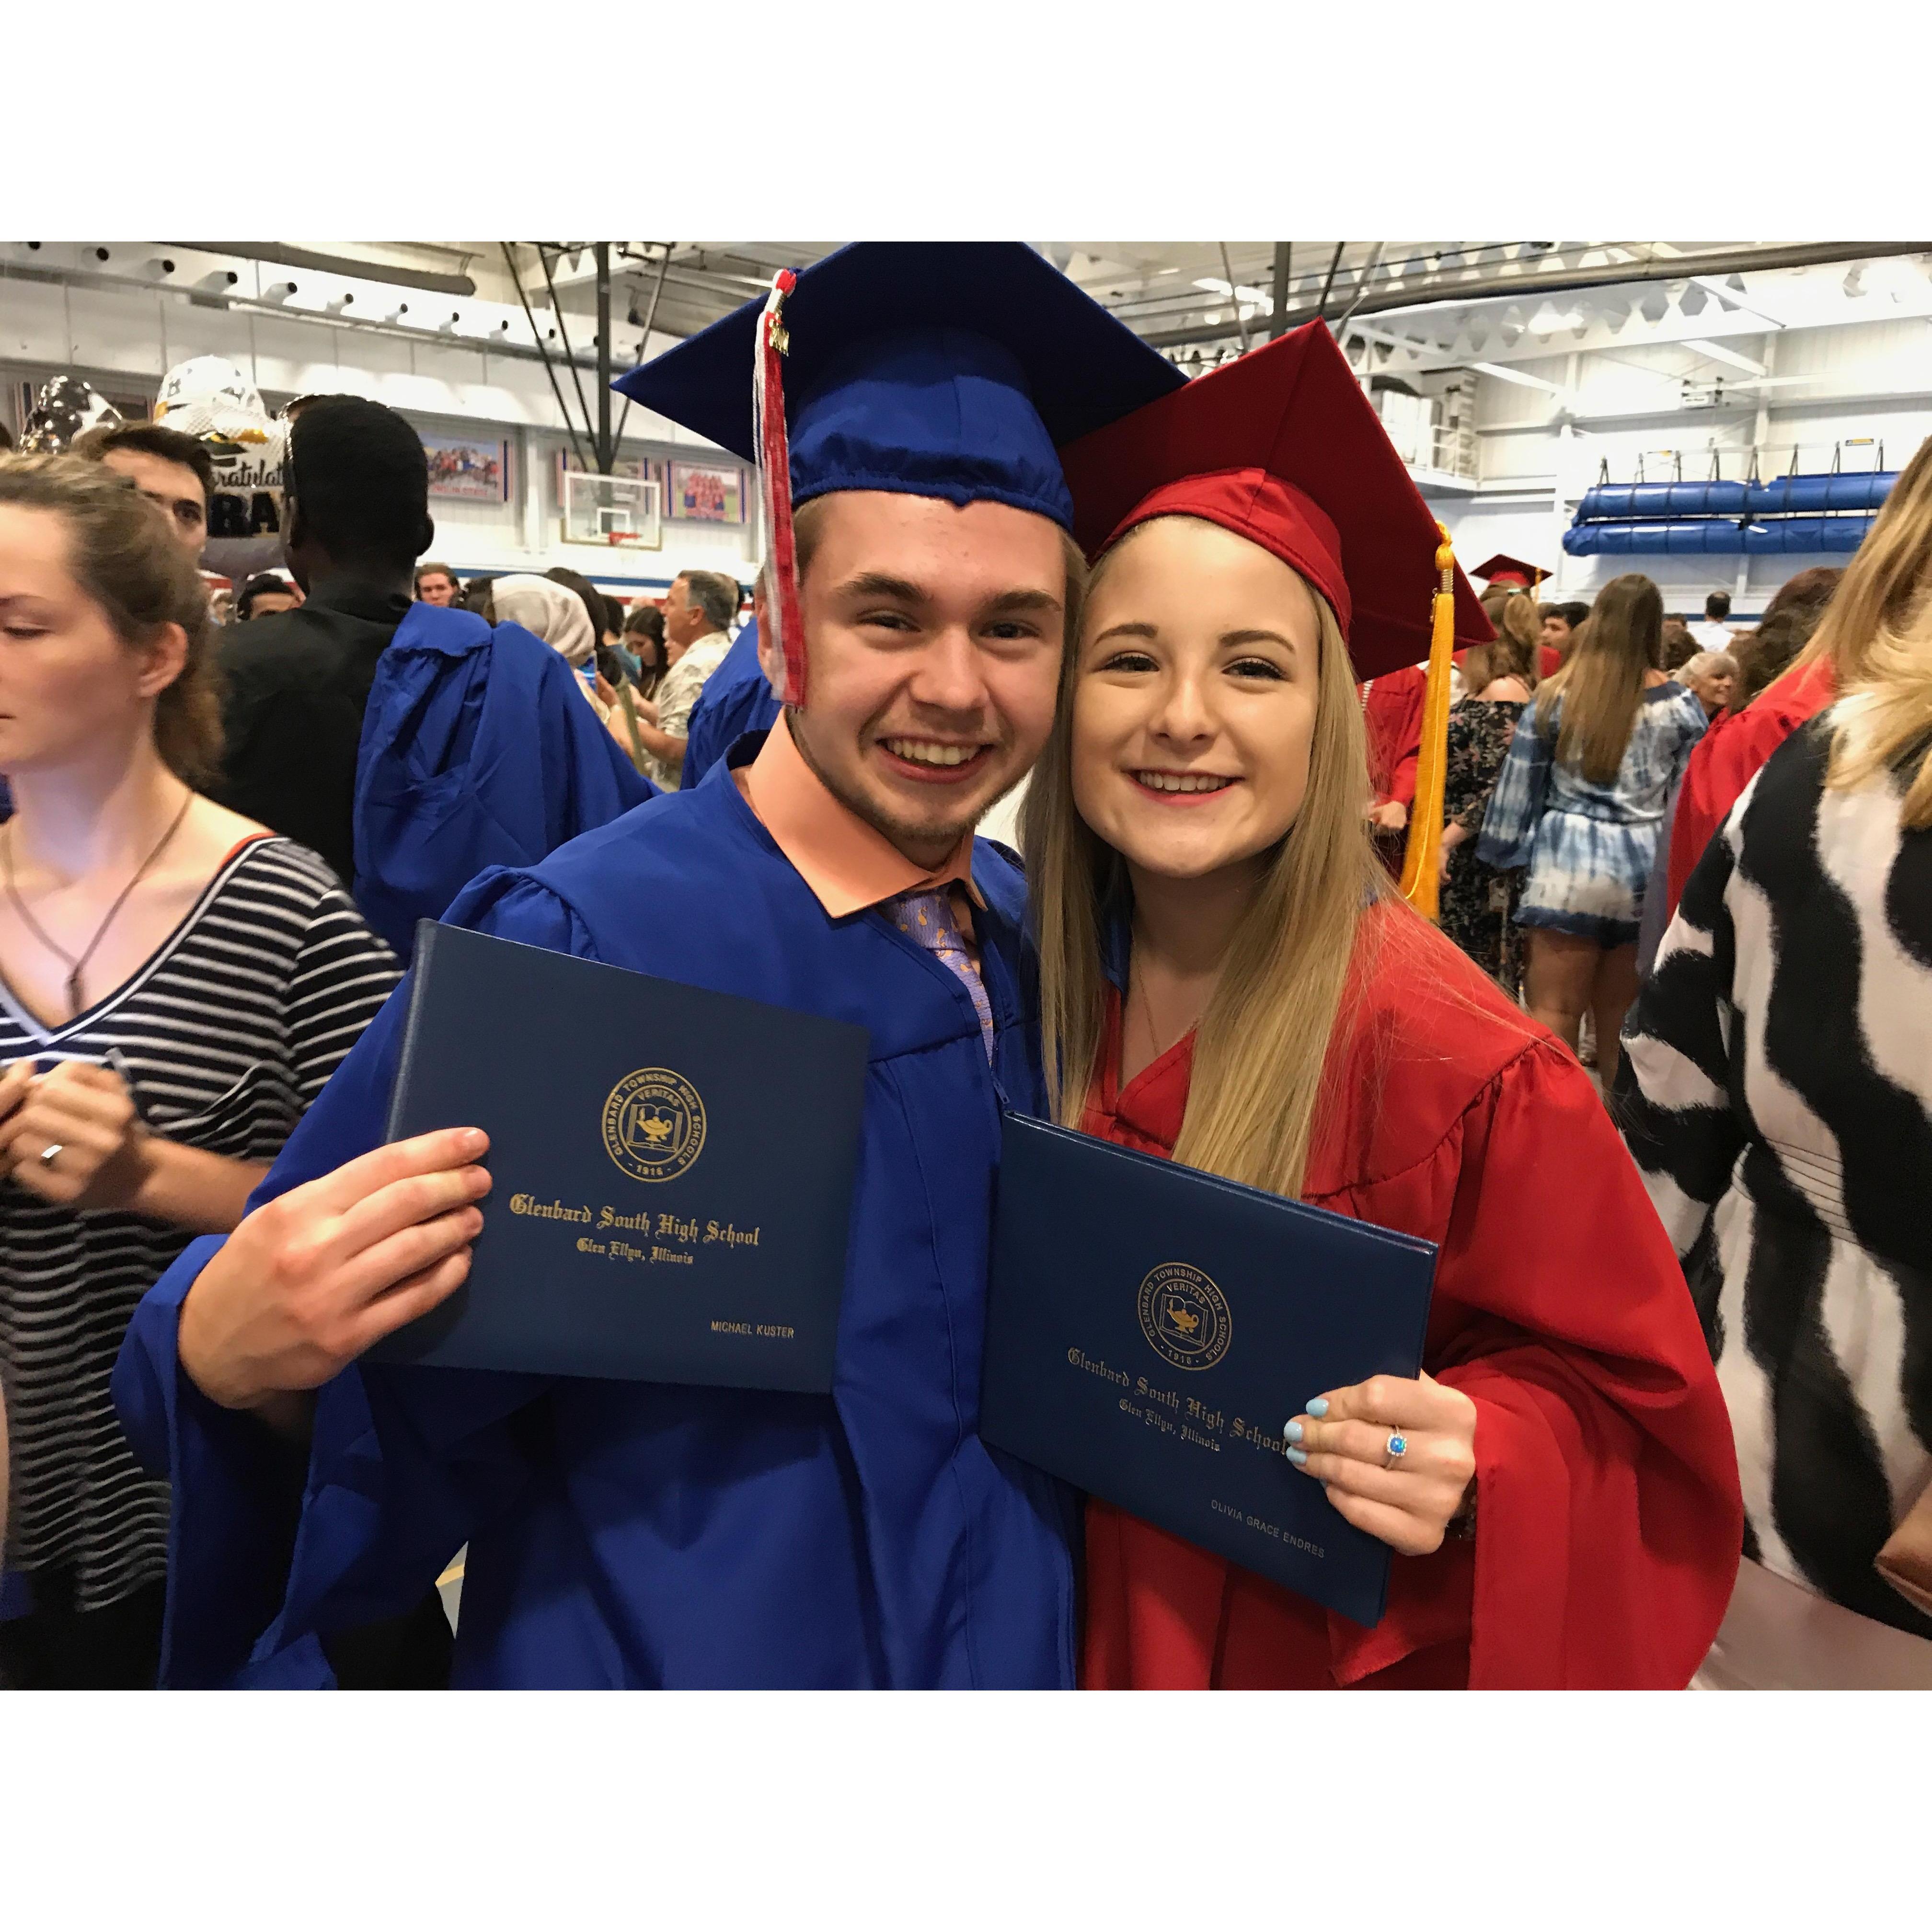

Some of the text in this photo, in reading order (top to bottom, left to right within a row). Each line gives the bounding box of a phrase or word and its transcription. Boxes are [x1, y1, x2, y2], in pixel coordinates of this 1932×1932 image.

[606, 1073, 702, 1166] GLENBARD TOWNSHIP HIGH SCHOOLS
[637, 1088, 680, 1108] VERITAS
[509, 1193, 760, 1249] Glenbard South High School
[576, 1237, 694, 1265] Glen Ellyn, Illinois
[1142, 1268, 1227, 1361] GLENBARD TOWNSHIP HIGH SCHOOLS
[1166, 1282, 1206, 1304] VERITAS
[711, 1319, 794, 1339] MICHAEL KUSTER
[1067, 1346, 1289, 1456] Glenbard South High School
[1119, 1398, 1220, 1452] Glen Ellyn, Illinois
[1211, 1499, 1325, 1558] OLIVIA GRACE ENDRES
